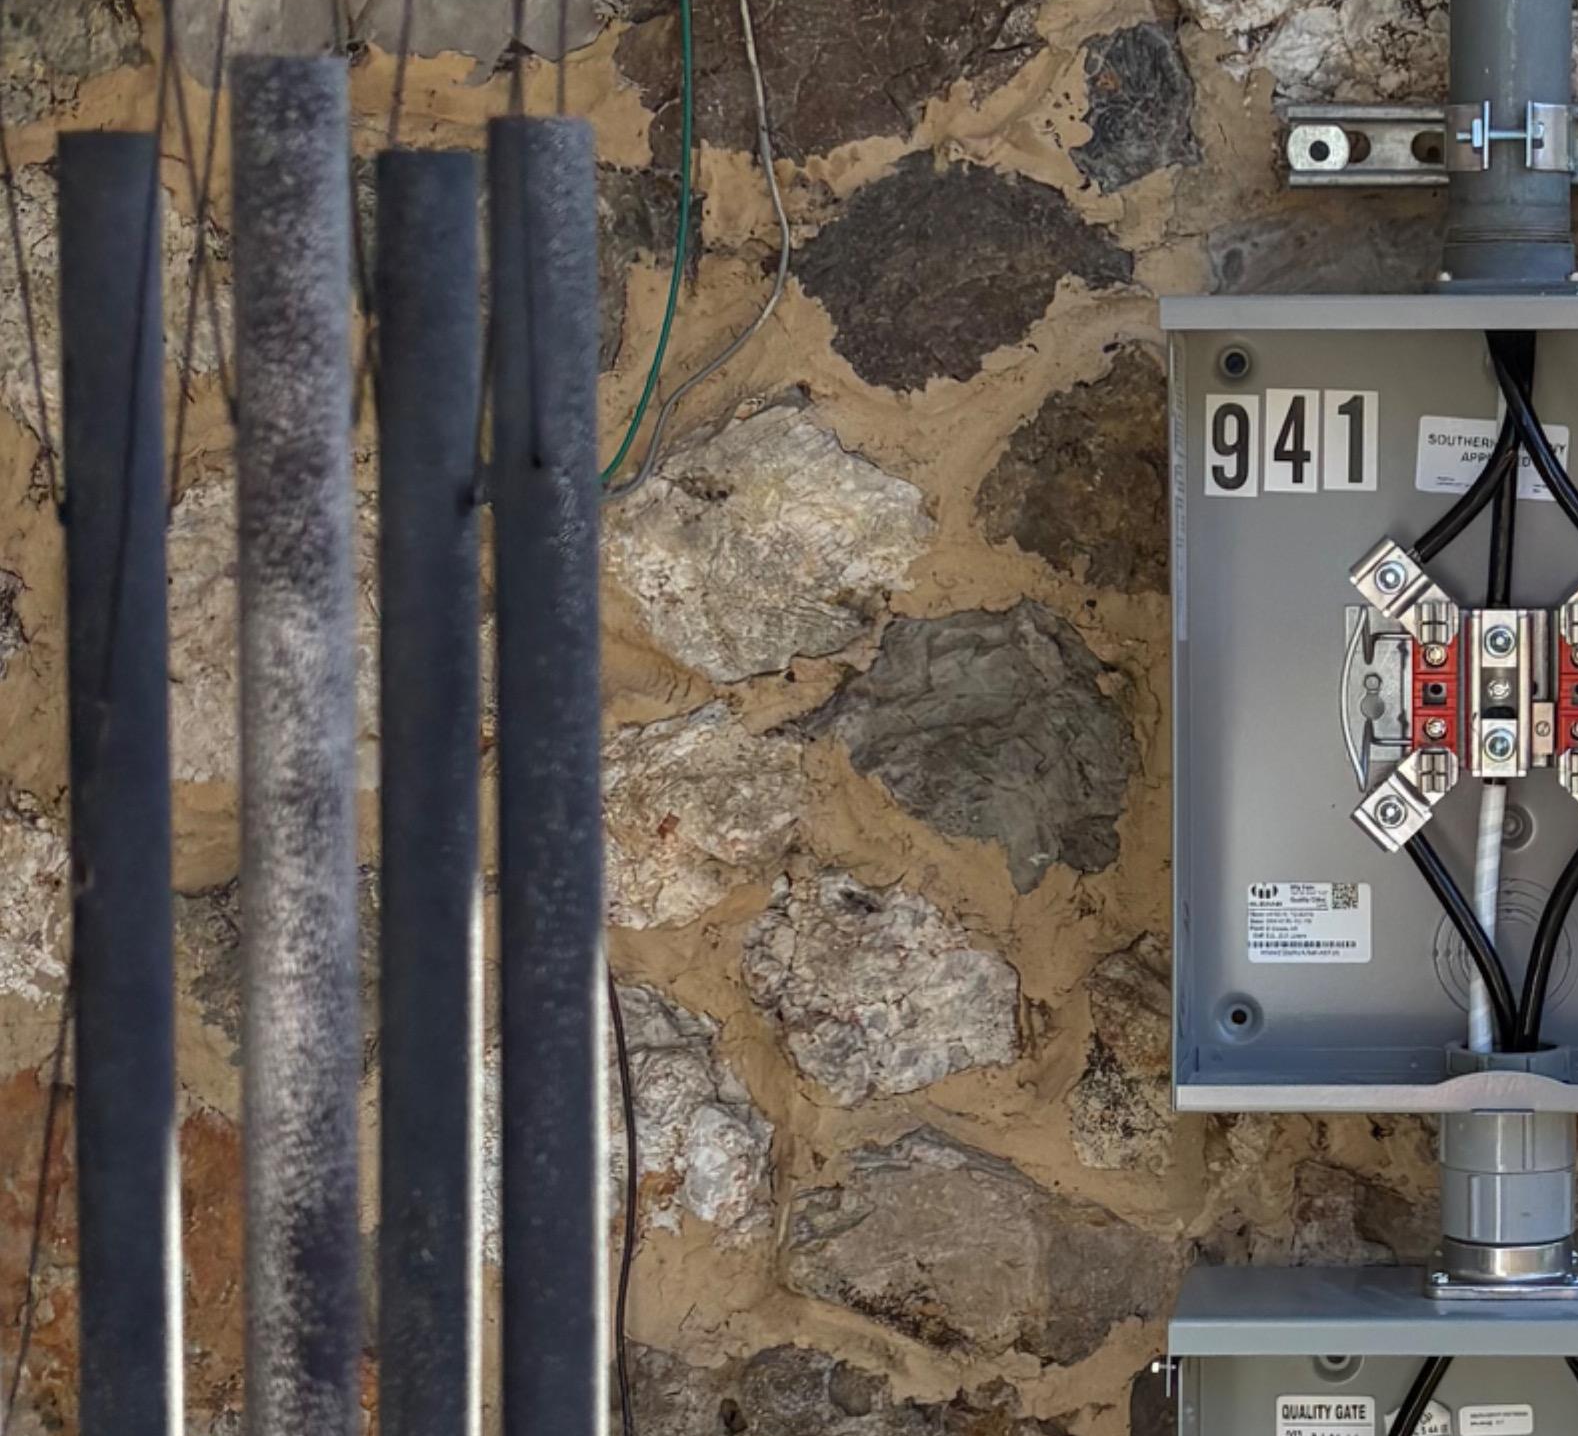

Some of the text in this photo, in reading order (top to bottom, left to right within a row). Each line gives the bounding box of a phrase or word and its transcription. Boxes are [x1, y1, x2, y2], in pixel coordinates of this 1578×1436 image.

[1212, 395, 1364, 490] 941
[1282, 1404, 1366, 1420] QUALITY GATE
